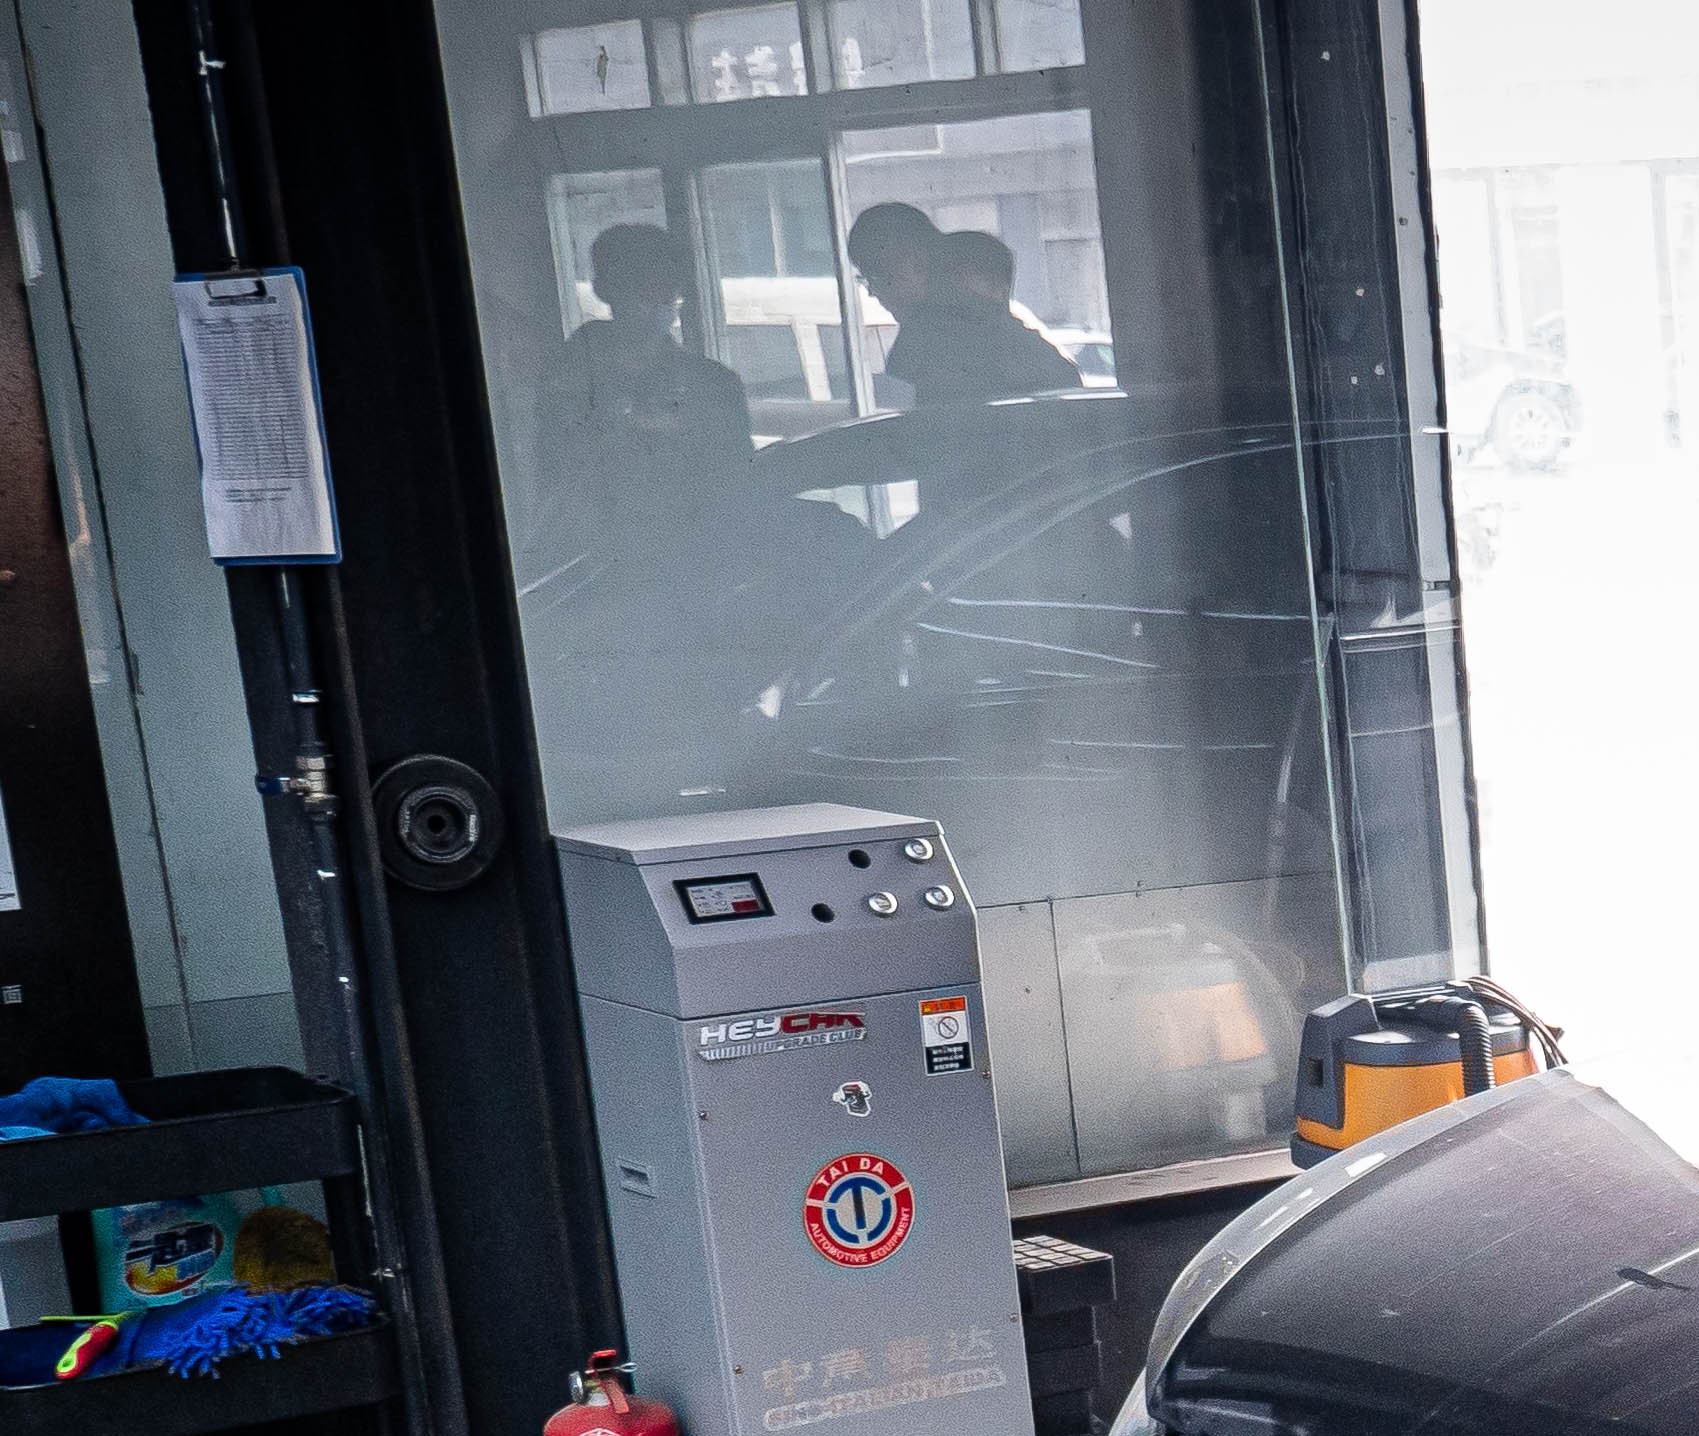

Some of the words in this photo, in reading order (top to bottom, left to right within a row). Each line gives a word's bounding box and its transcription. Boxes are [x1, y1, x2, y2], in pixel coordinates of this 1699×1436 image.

[815, 1160, 850, 1188] TAI
[858, 1157, 885, 1175] DA
[809, 1222, 869, 1264] AUTOMOTIVE
[870, 1206, 911, 1260] EQUIPMENT
